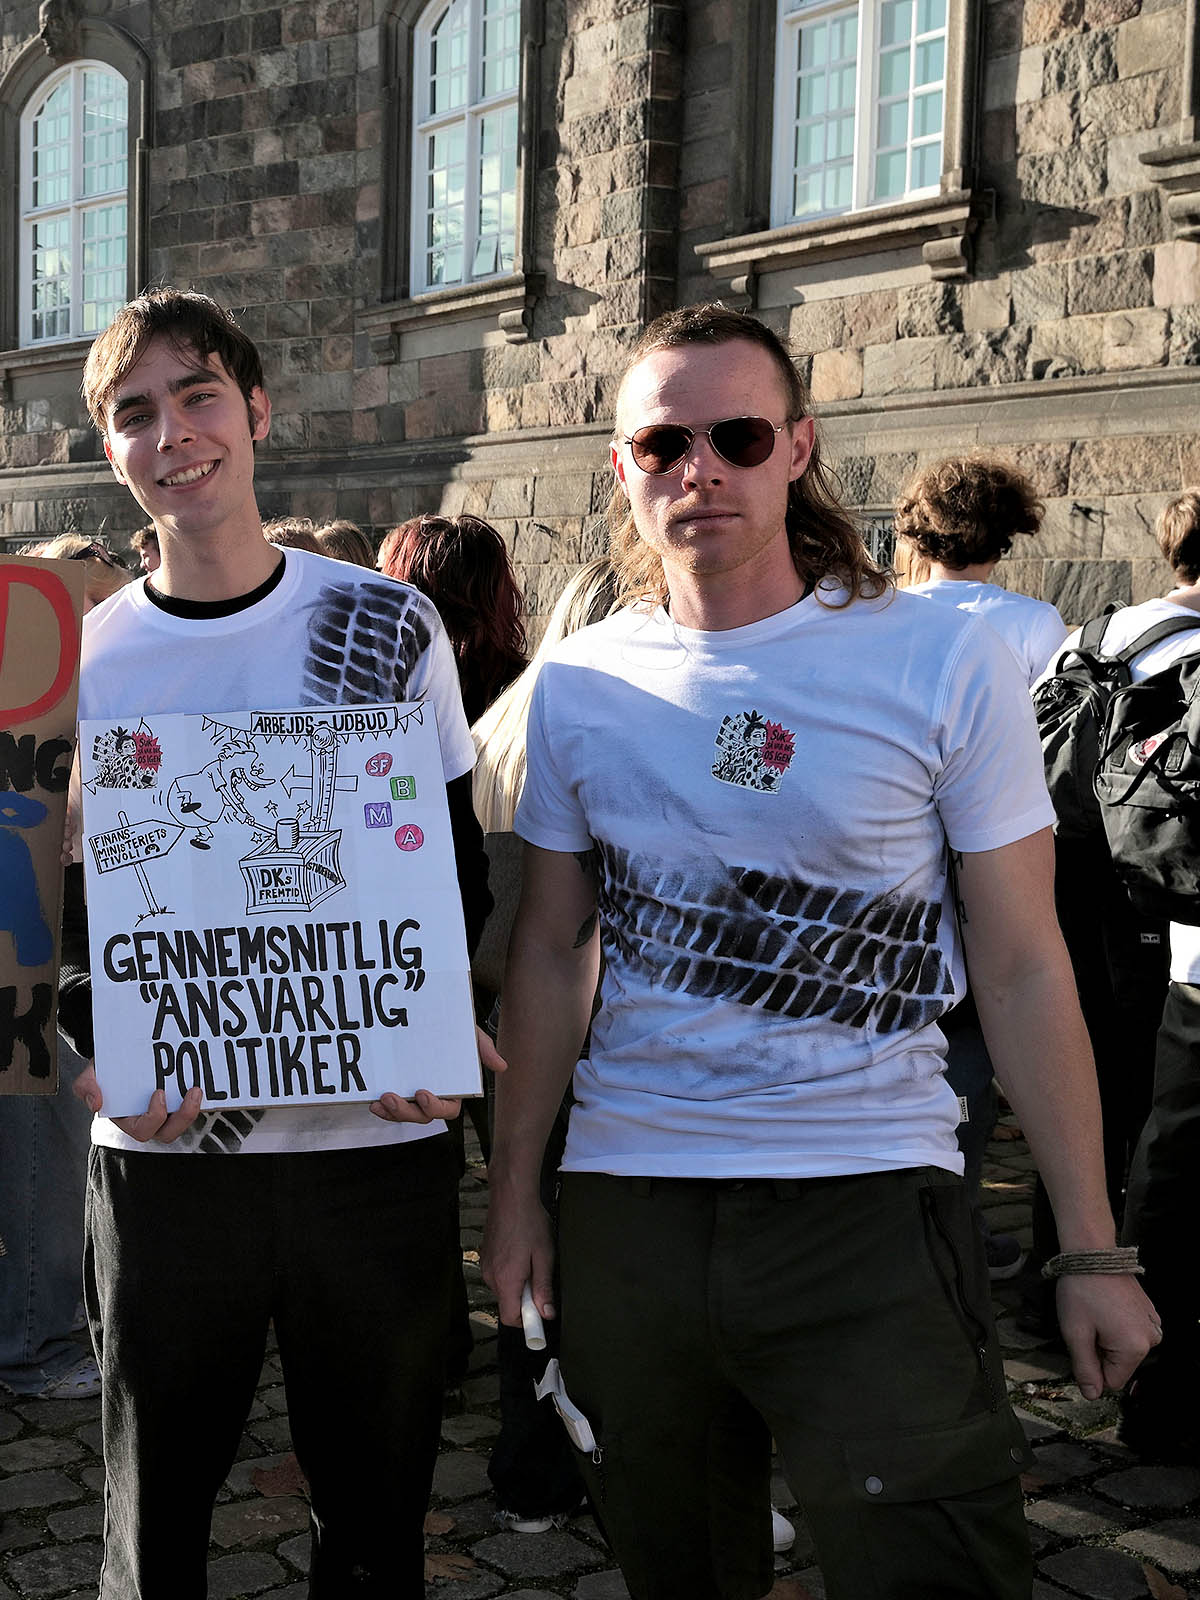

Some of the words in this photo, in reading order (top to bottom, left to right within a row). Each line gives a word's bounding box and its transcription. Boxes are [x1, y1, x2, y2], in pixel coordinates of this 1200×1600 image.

[370, 758, 389, 773] SF
[396, 779, 410, 797] B
[369, 807, 389, 825] M
[93, 828, 136, 849] FINANS-
[97, 828, 167, 859] MINISTERIETS
[403, 831, 417, 845] A
[100, 849, 141, 868] TIVOLI
[259, 887, 300, 901] FREMTID
[103, 918, 423, 983] GENNEMSNITLIG
[139, 969, 426, 1040] “ANSVARLIG”
[152, 1033, 368, 1101] POLITIKER
